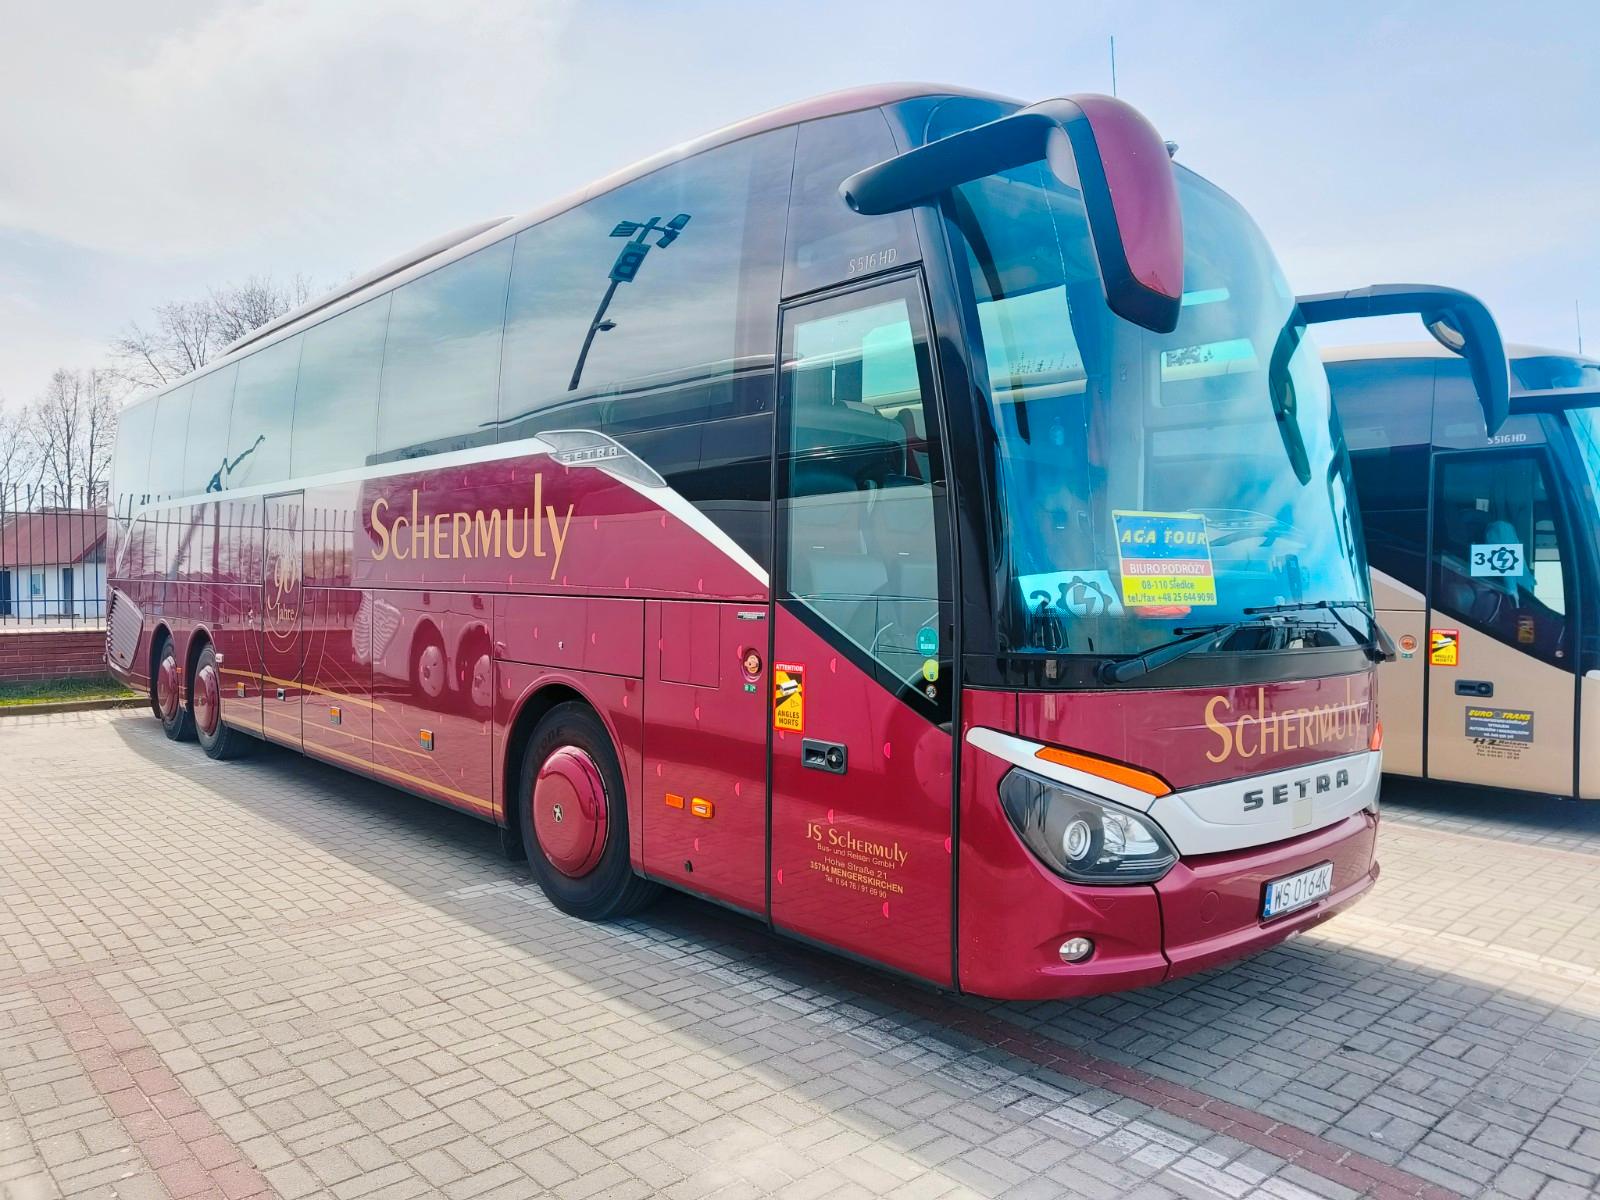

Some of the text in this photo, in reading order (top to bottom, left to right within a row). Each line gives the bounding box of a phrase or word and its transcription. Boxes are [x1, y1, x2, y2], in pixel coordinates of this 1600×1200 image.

[858, 254, 876, 271] 516
[880, 248, 897, 264] HD
[1494, 434, 1510, 444] 516
[1512, 434, 1526, 442] HD
[562, 446, 618, 462] SETRA
[1120, 529, 1206, 544] AGA TOUR
[1474, 552, 1486, 566] 3
[1130, 563, 1160, 574] BIURO
[1142, 580, 1168, 590] 08-110
[1158, 593, 1172, 602] +48
[1172, 592, 1182, 602] 25
[276, 602, 295, 624] Jahre
[778, 710, 800, 719] ANGLES
[778, 718, 799, 727] MORTS
[1244, 768, 1349, 812] SETRA
[806, 823, 822, 841] JS
[834, 848, 846, 856] und
[847, 850, 870, 862] Reisen
[872, 858, 895, 870] GmbH
[824, 856, 888, 880] Hohe Straße 21
[830, 866, 904, 894] MENGERSKIRCHEN
[1275, 867, 1330, 910] WS 0164K
